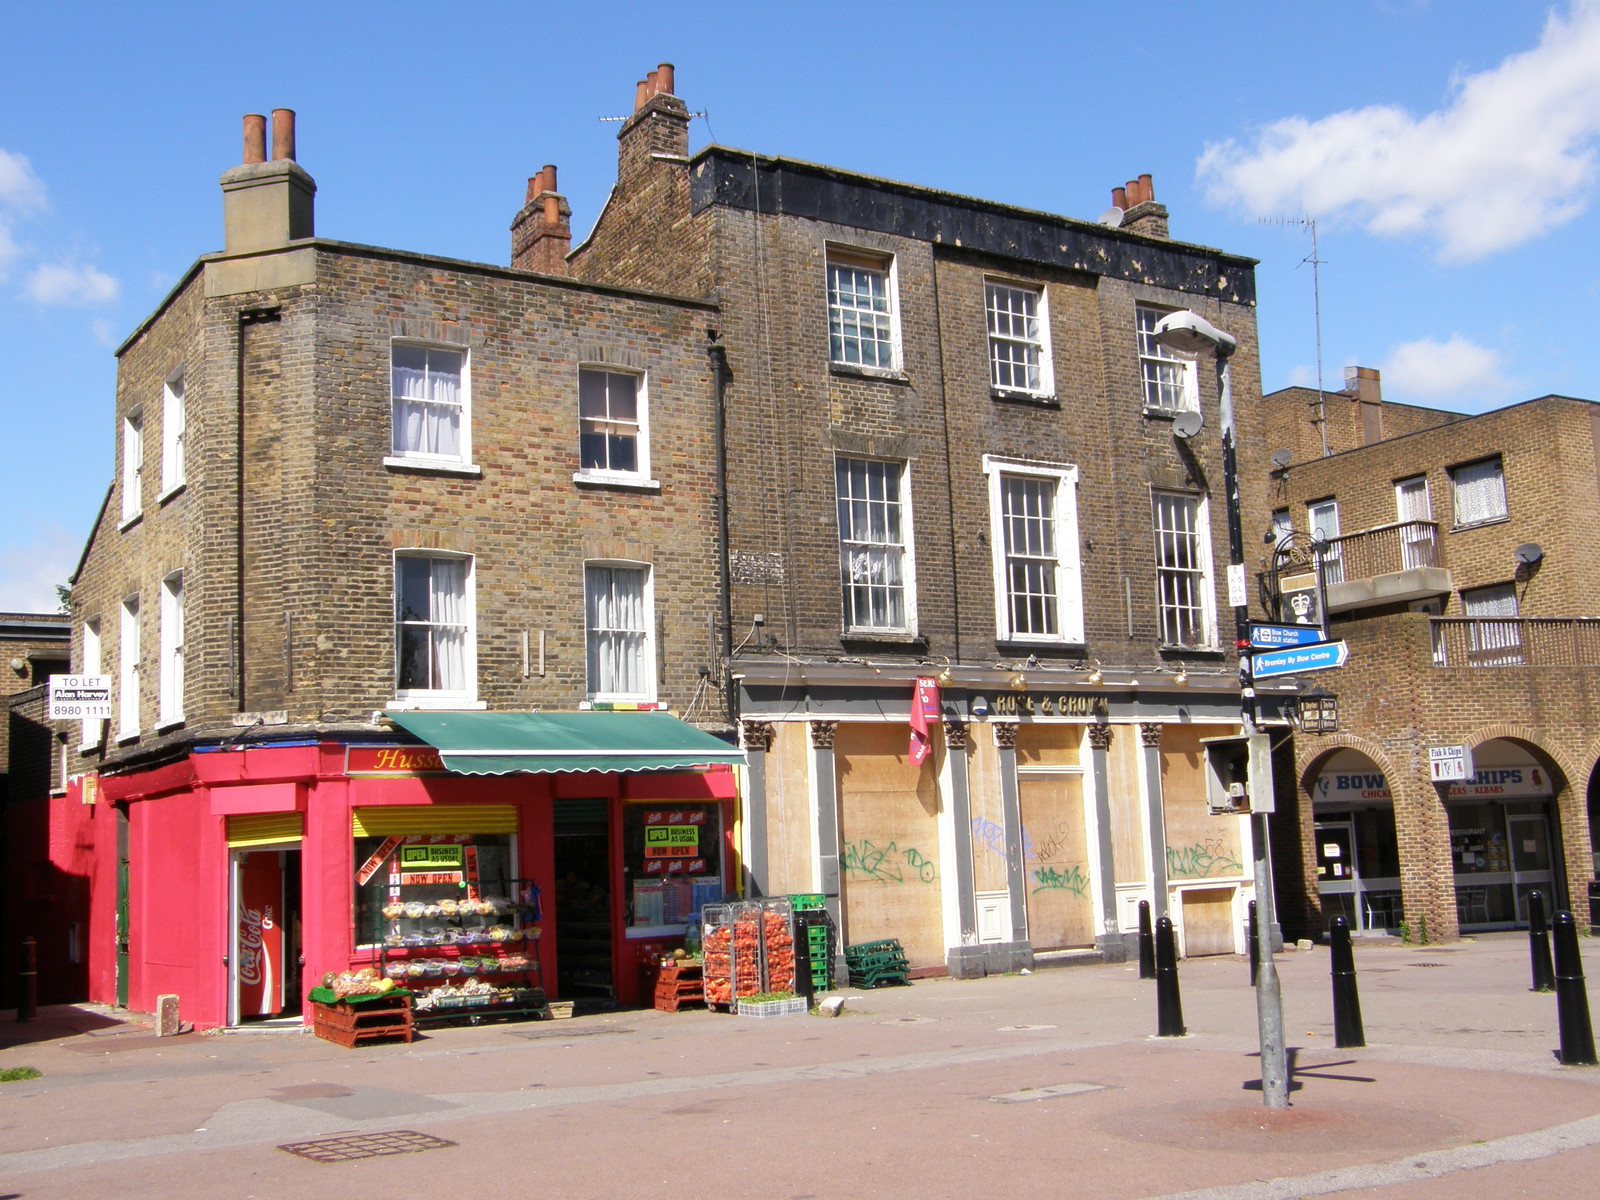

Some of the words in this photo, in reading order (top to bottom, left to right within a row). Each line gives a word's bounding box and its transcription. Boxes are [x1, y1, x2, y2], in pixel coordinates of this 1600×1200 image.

[1265, 659, 1286, 667] Bromley
[63, 678, 78, 687] TO
[83, 678, 101, 687] LET
[55, 688, 76, 698] Alan
[77, 690, 109, 701] Harvey
[997, 696, 1034, 712] ROSE
[1042, 697, 1054, 712] &
[54, 706, 81, 715] 8980
[86, 706, 110, 715] 1111
[1432, 749, 1442, 757] Fish
[1443, 748, 1447, 756] &
[1448, 748, 1462, 757] Chips
[1336, 775, 1384, 789] BOW
[1474, 786, 1504, 794] KEBABS
[650, 829, 667, 840] OPEN
[361, 857, 378, 877] NOW
[376, 837, 396, 858] OPEN
[406, 849, 426, 860] OPEN
[652, 848, 667, 856] NOW
[672, 847, 689, 856] OPEN
[410, 874, 427, 884] NOW
[432, 873, 453, 882] OPEN
[262, 905, 274, 930] Coke
